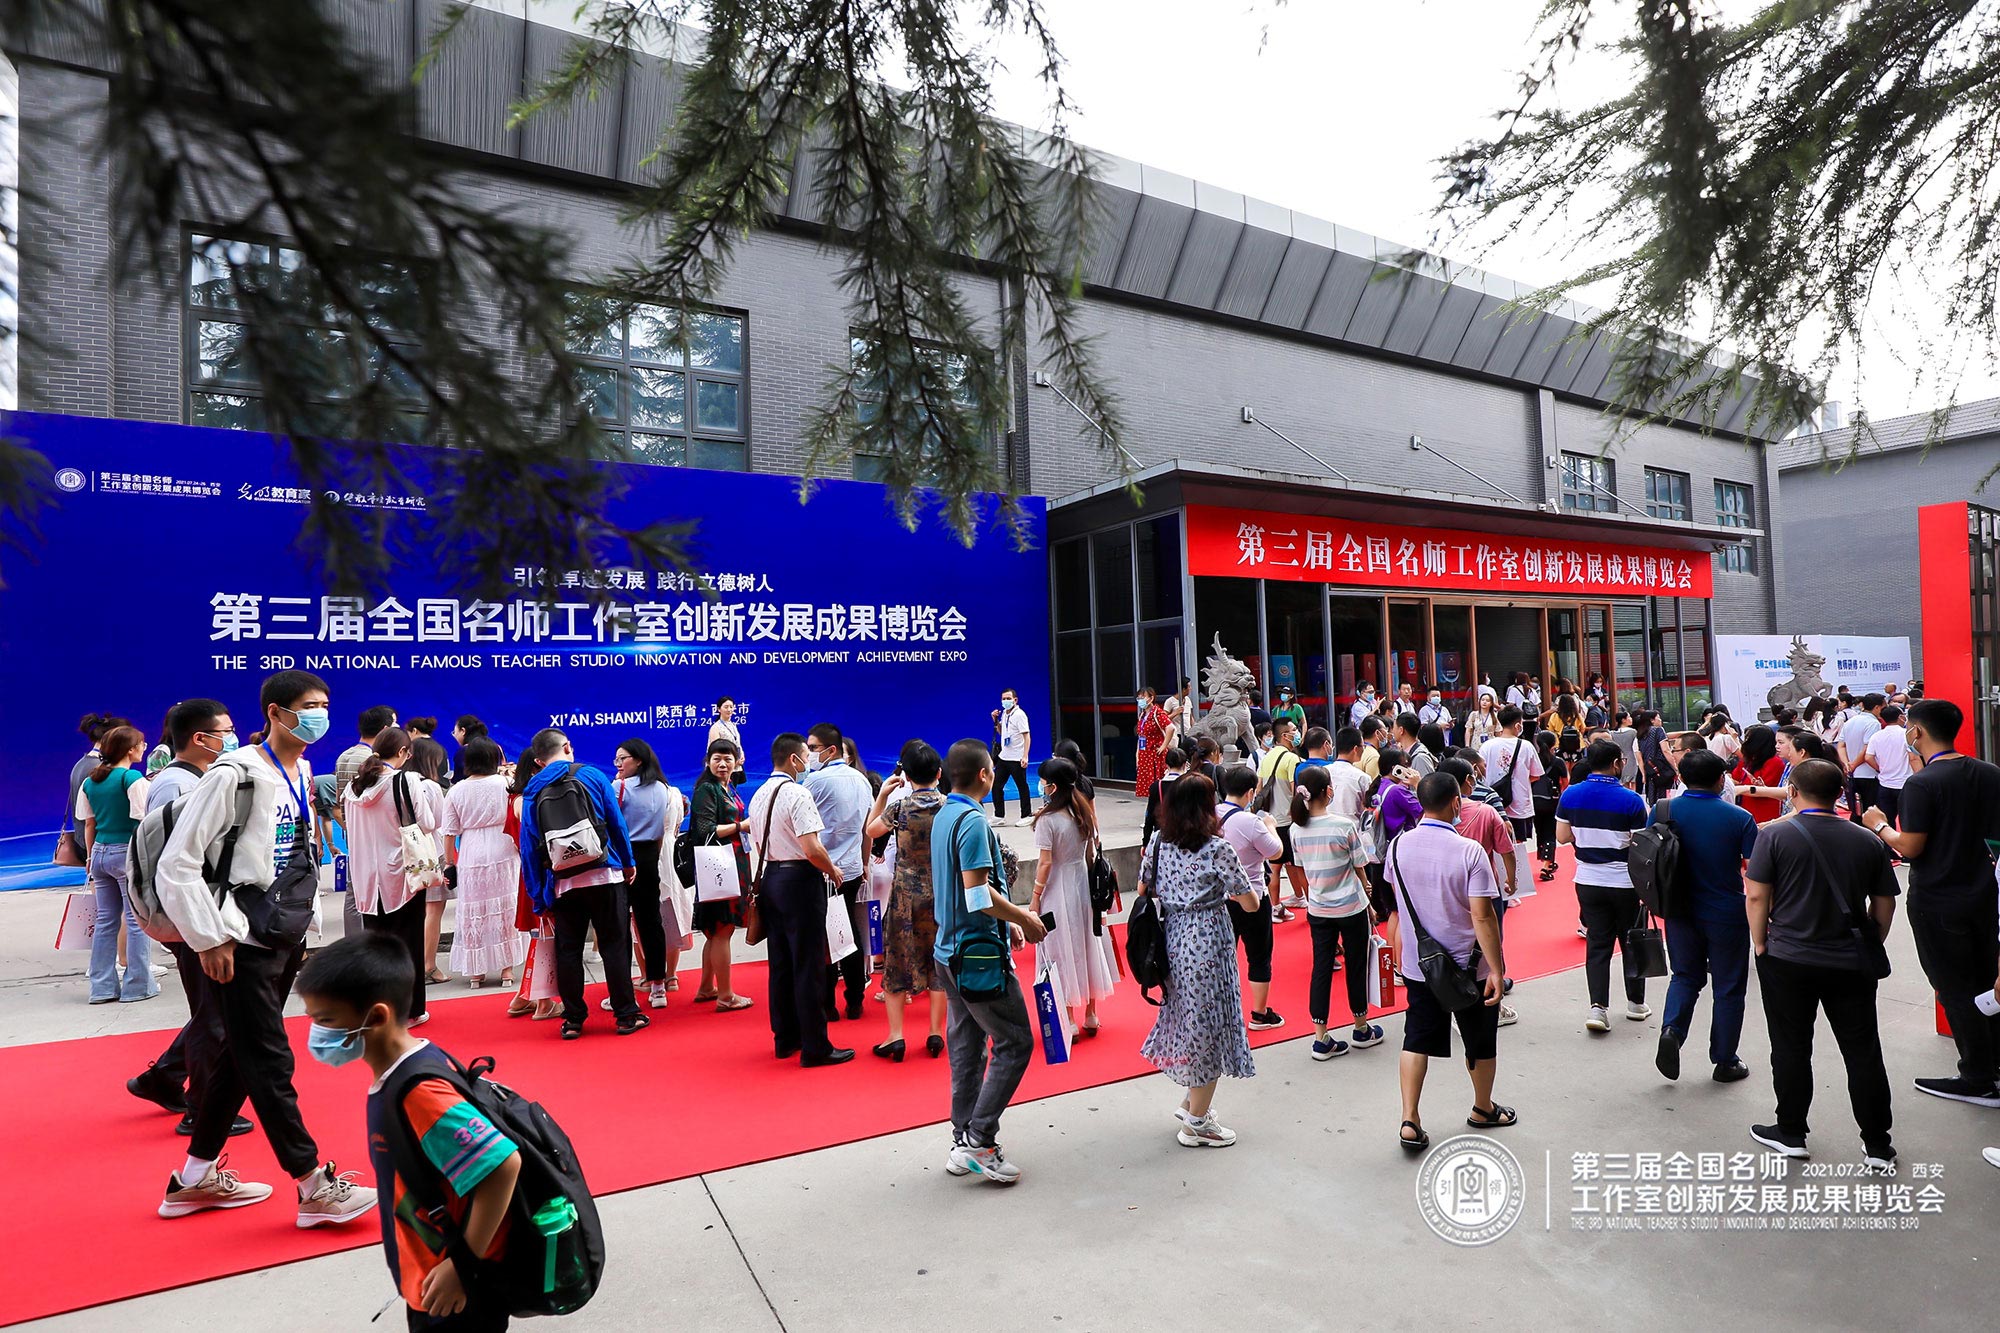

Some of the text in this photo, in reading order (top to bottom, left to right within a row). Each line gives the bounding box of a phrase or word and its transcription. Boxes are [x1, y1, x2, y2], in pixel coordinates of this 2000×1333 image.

[101, 472, 172, 485] 第三届全国名师
[101, 481, 221, 496] 工作室创新发展成果博览会
[1236, 522, 1692, 589] 第三届全国名师工作室创新发展成果博览会
[657, 571, 774, 593] 践行立德树人
[210, 592, 966, 643] 第三届全国名师工作室创新发展成果博览会
[211, 650, 967, 670] THE 3RD NATIONAL FAMOUS TEACHER STUDIO INNOVATION AND DEVELOPMENT ACHIEVEMENT EXPO
[656, 702, 750, 718] 陕西省·西市
[562, 848, 589, 861] adidas
[454, 1117, 487, 1146] 33
